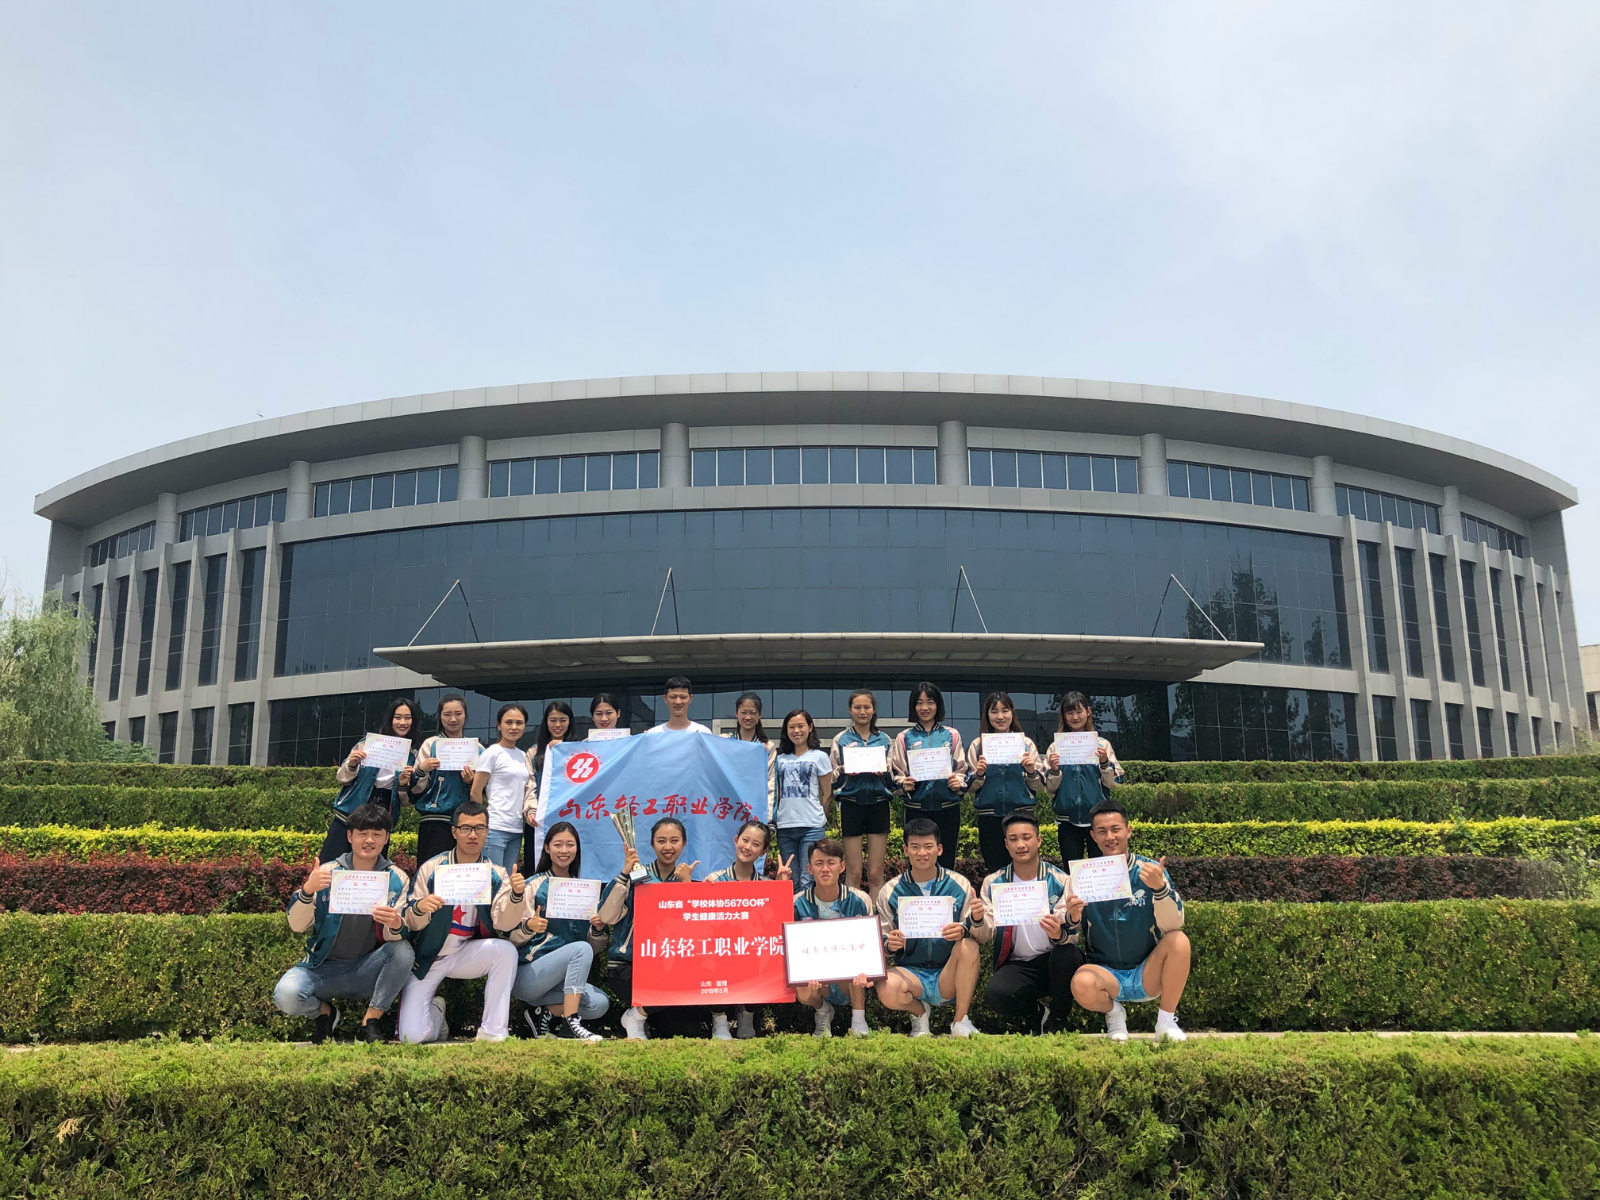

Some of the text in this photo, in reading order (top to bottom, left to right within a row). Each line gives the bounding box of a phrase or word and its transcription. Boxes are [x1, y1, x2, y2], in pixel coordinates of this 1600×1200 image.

[558, 793, 761, 823] 山东轻工职业学院
[682, 911, 749, 922] 学生健康活力大赛
[640, 935, 784, 959] 山东轻工职业学院
